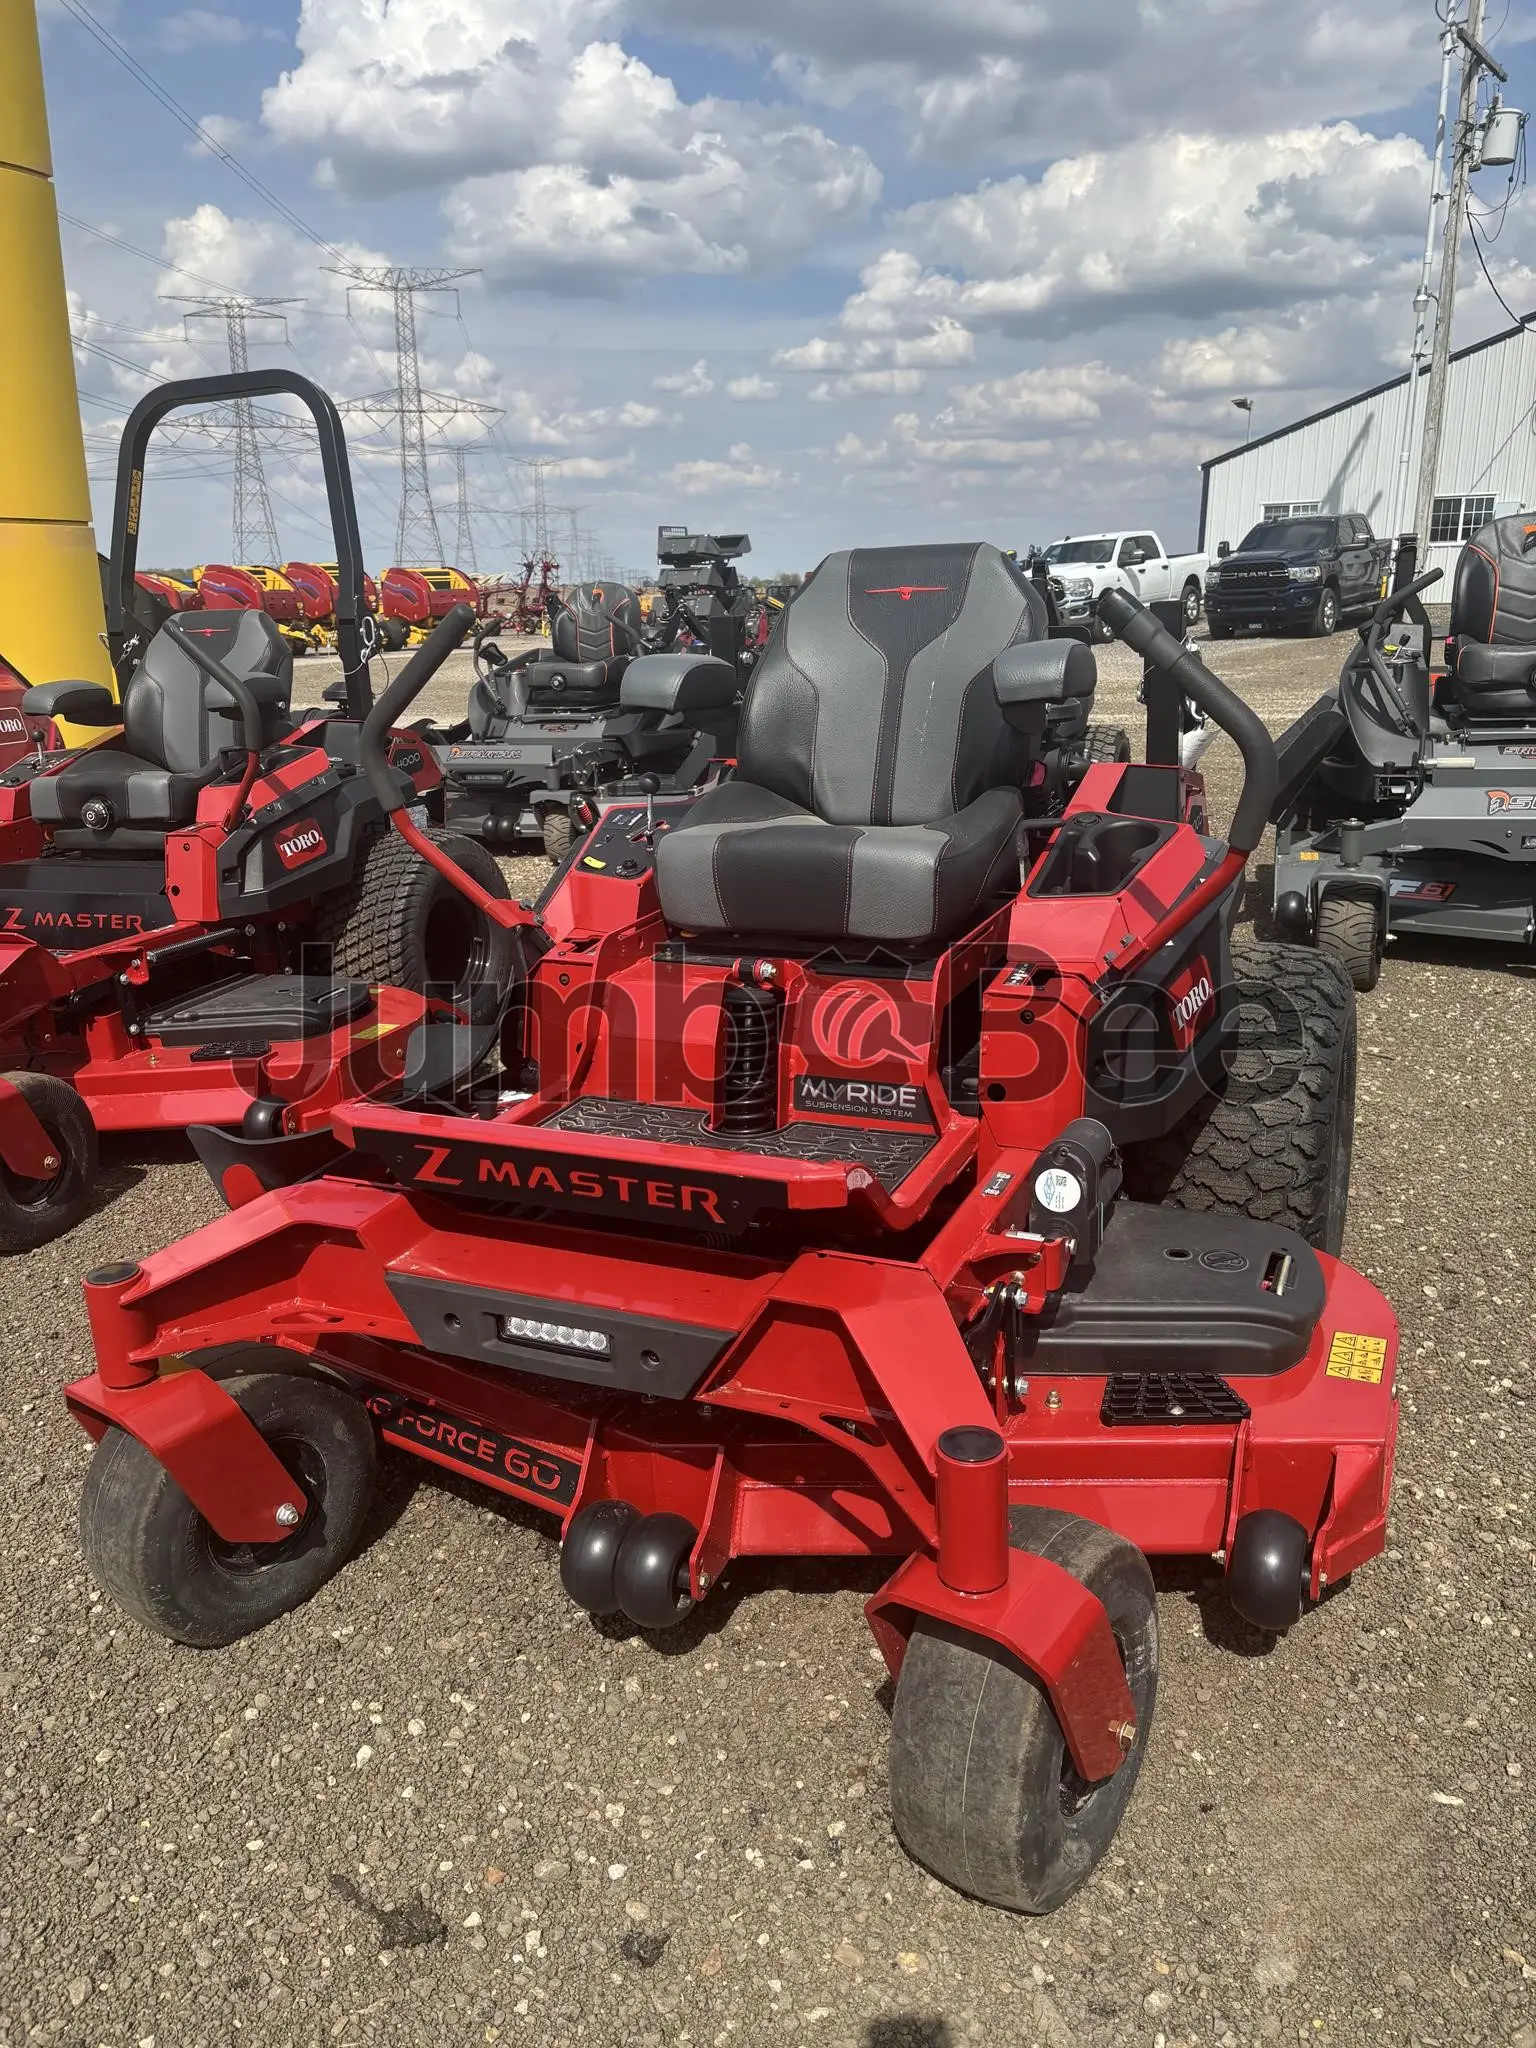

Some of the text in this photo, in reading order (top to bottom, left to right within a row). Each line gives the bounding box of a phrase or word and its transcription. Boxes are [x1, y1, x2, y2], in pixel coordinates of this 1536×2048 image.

[1238, 570, 1268, 578] RAM
[0, 718, 22, 733] ORO
[396, 752, 421, 769] 4000
[280, 829, 323, 858] TORO
[3, 907, 146, 934] Z MASTER
[1172, 977, 1215, 1031] TORO
[805, 1099, 913, 1118] SUSPENSION SYSTEM
[412, 1144, 726, 1225] Z MASTER
[398, 1414, 497, 1463] FORCE
